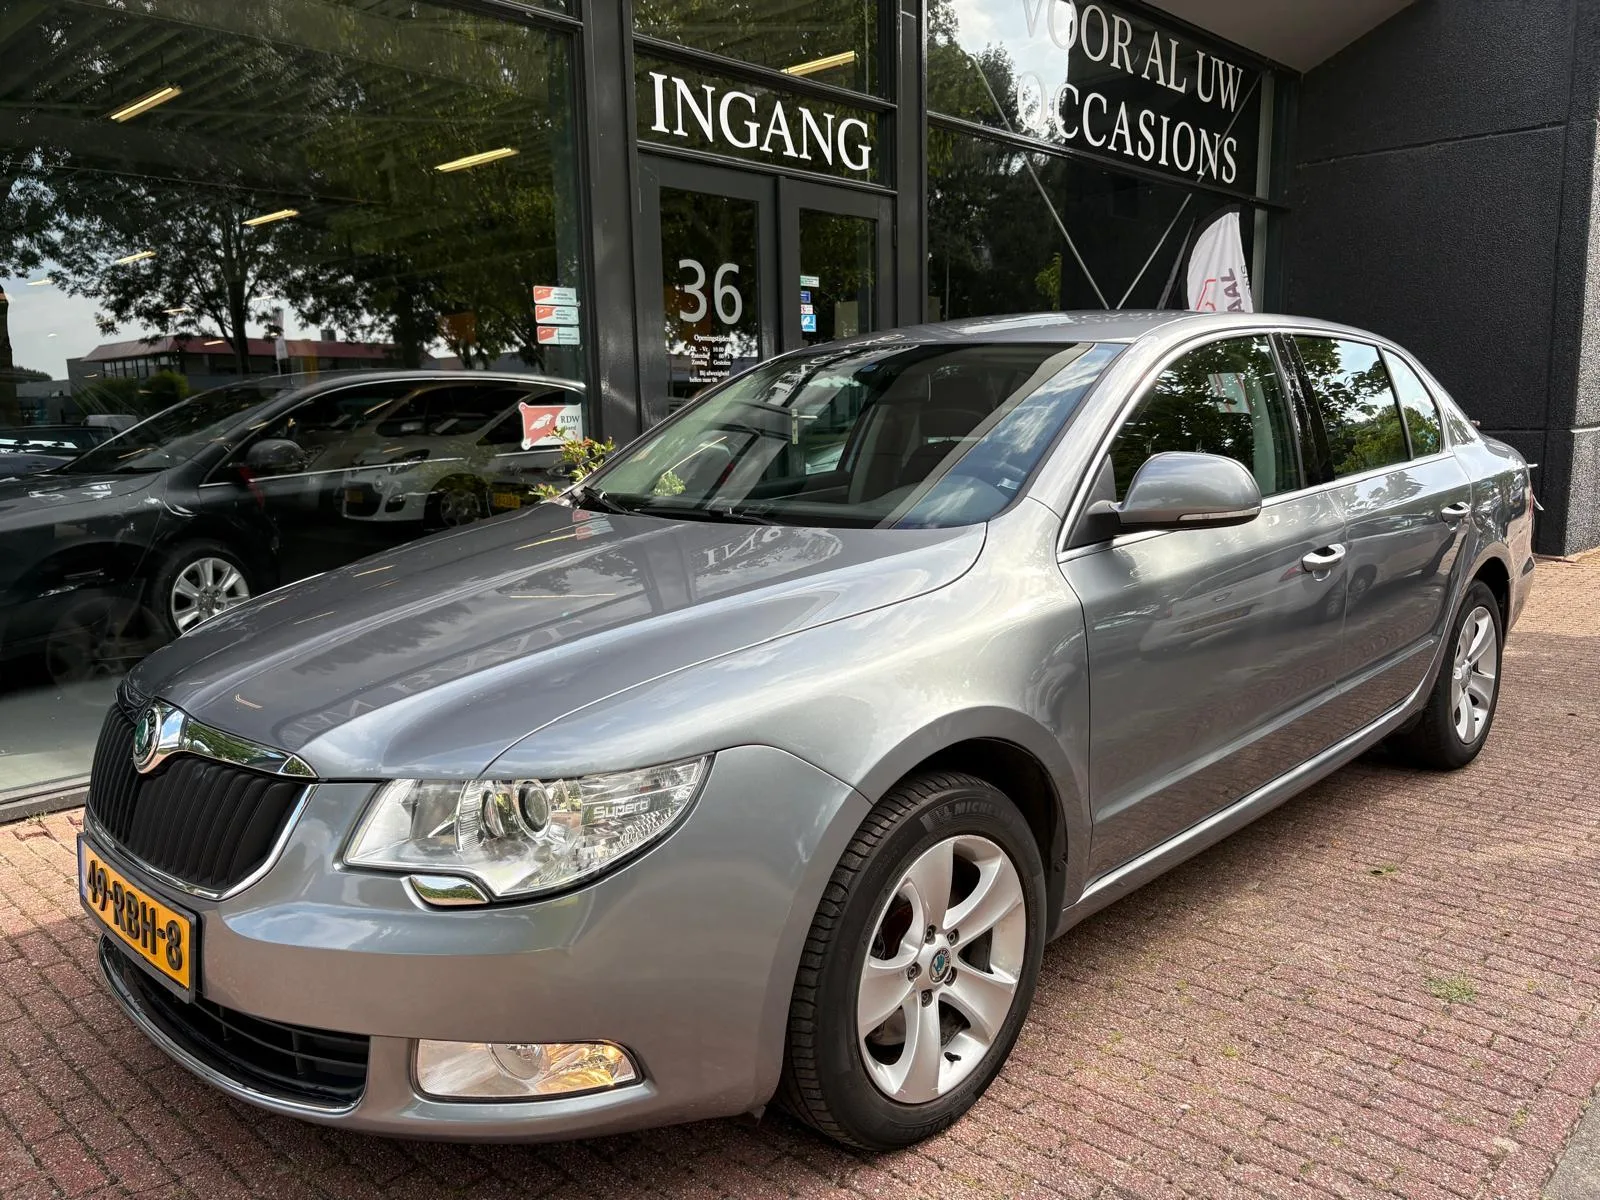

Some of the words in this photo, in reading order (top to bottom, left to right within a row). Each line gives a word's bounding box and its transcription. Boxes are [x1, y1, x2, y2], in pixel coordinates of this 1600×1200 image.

[1022, 0, 1134, 75] VOOR
[1141, 31, 1187, 94] AL
[1196, 50, 1244, 113] UW
[649, 71, 872, 171] INGANG
[1017, 71, 1238, 184] OCCASIONS
[678, 258, 743, 325] 36
[560, 415, 581, 424] RDW
[87, 859, 184, 971] 49-RBH-8
